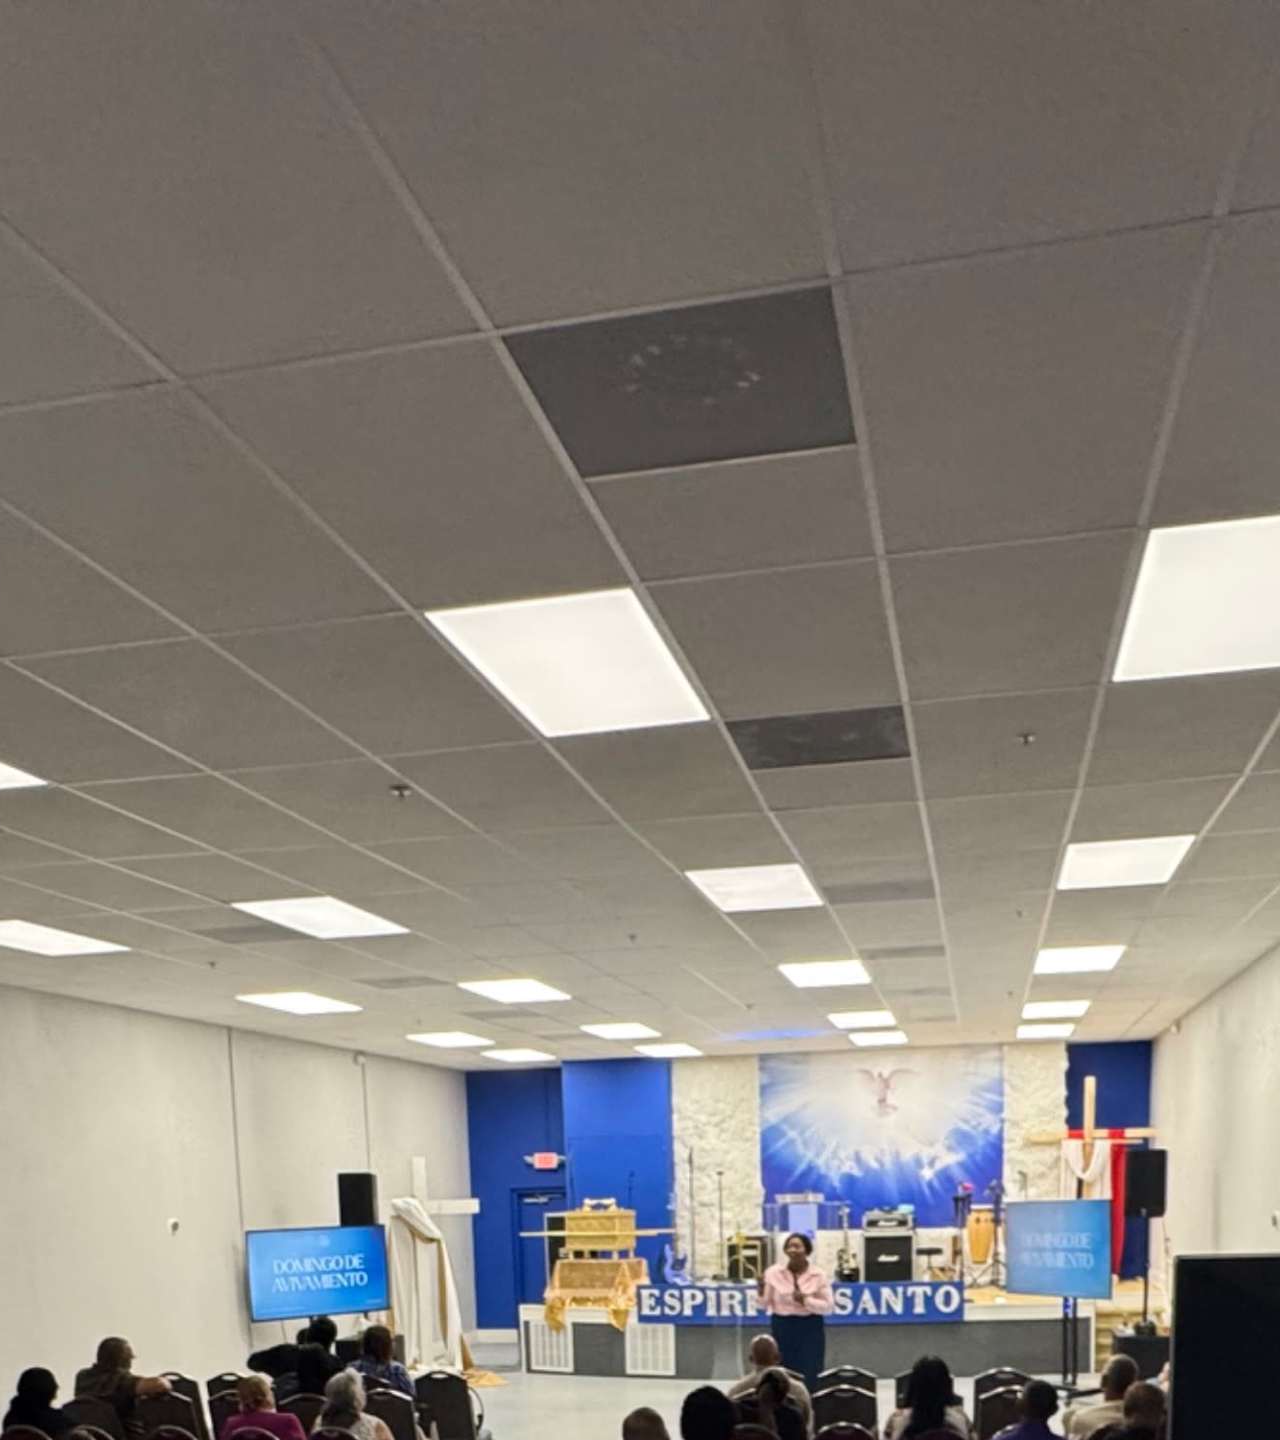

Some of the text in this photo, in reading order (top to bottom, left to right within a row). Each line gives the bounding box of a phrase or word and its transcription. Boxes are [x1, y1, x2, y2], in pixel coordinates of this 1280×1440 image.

[272, 1253, 365, 1275] DOMINGO DE
[639, 1285, 961, 1317] ESPIRI SANTO
